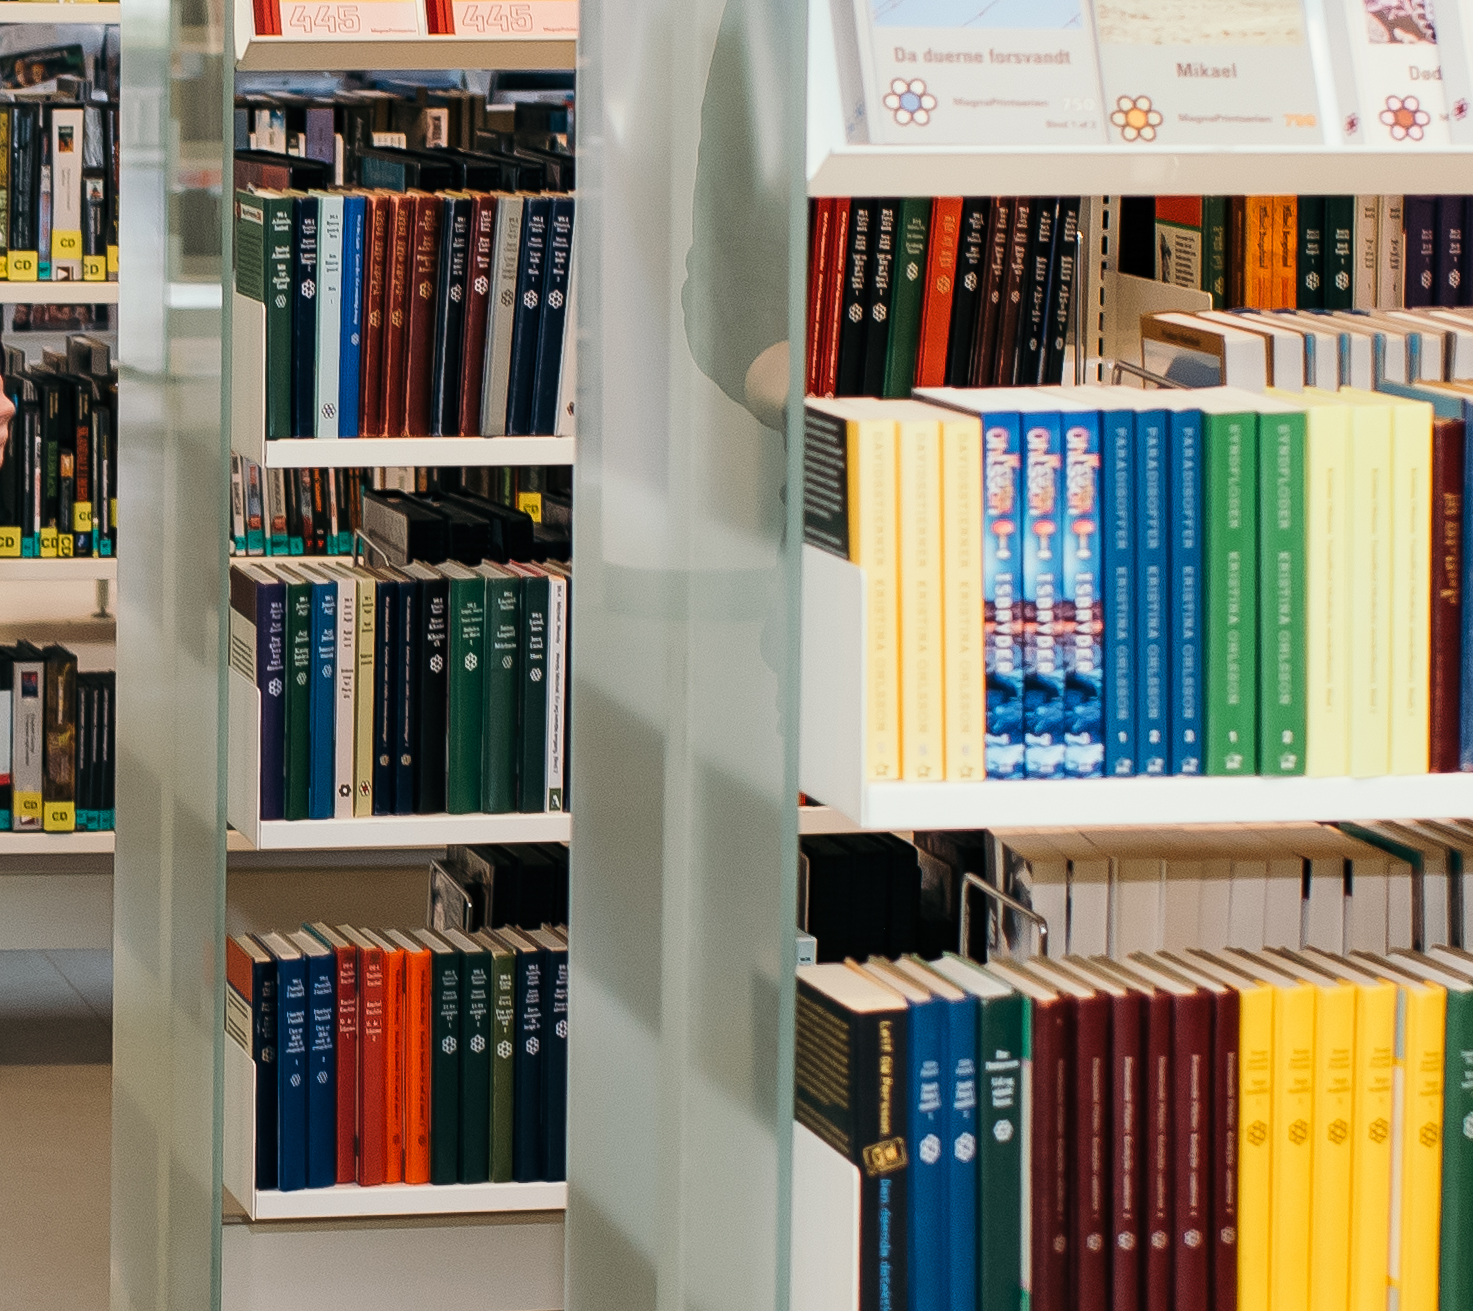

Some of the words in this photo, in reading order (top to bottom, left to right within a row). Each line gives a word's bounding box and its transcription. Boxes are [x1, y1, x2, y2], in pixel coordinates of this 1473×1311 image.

[289, 4, 362, 34] 445
[462, 4, 535, 33] 445
[894, 46, 917, 63] Da
[923, 48, 984, 63] duerne
[989, 48, 1071, 65] forsvandt
[1176, 63, 1238, 78] Mikael
[14, 259, 32, 271] CD
